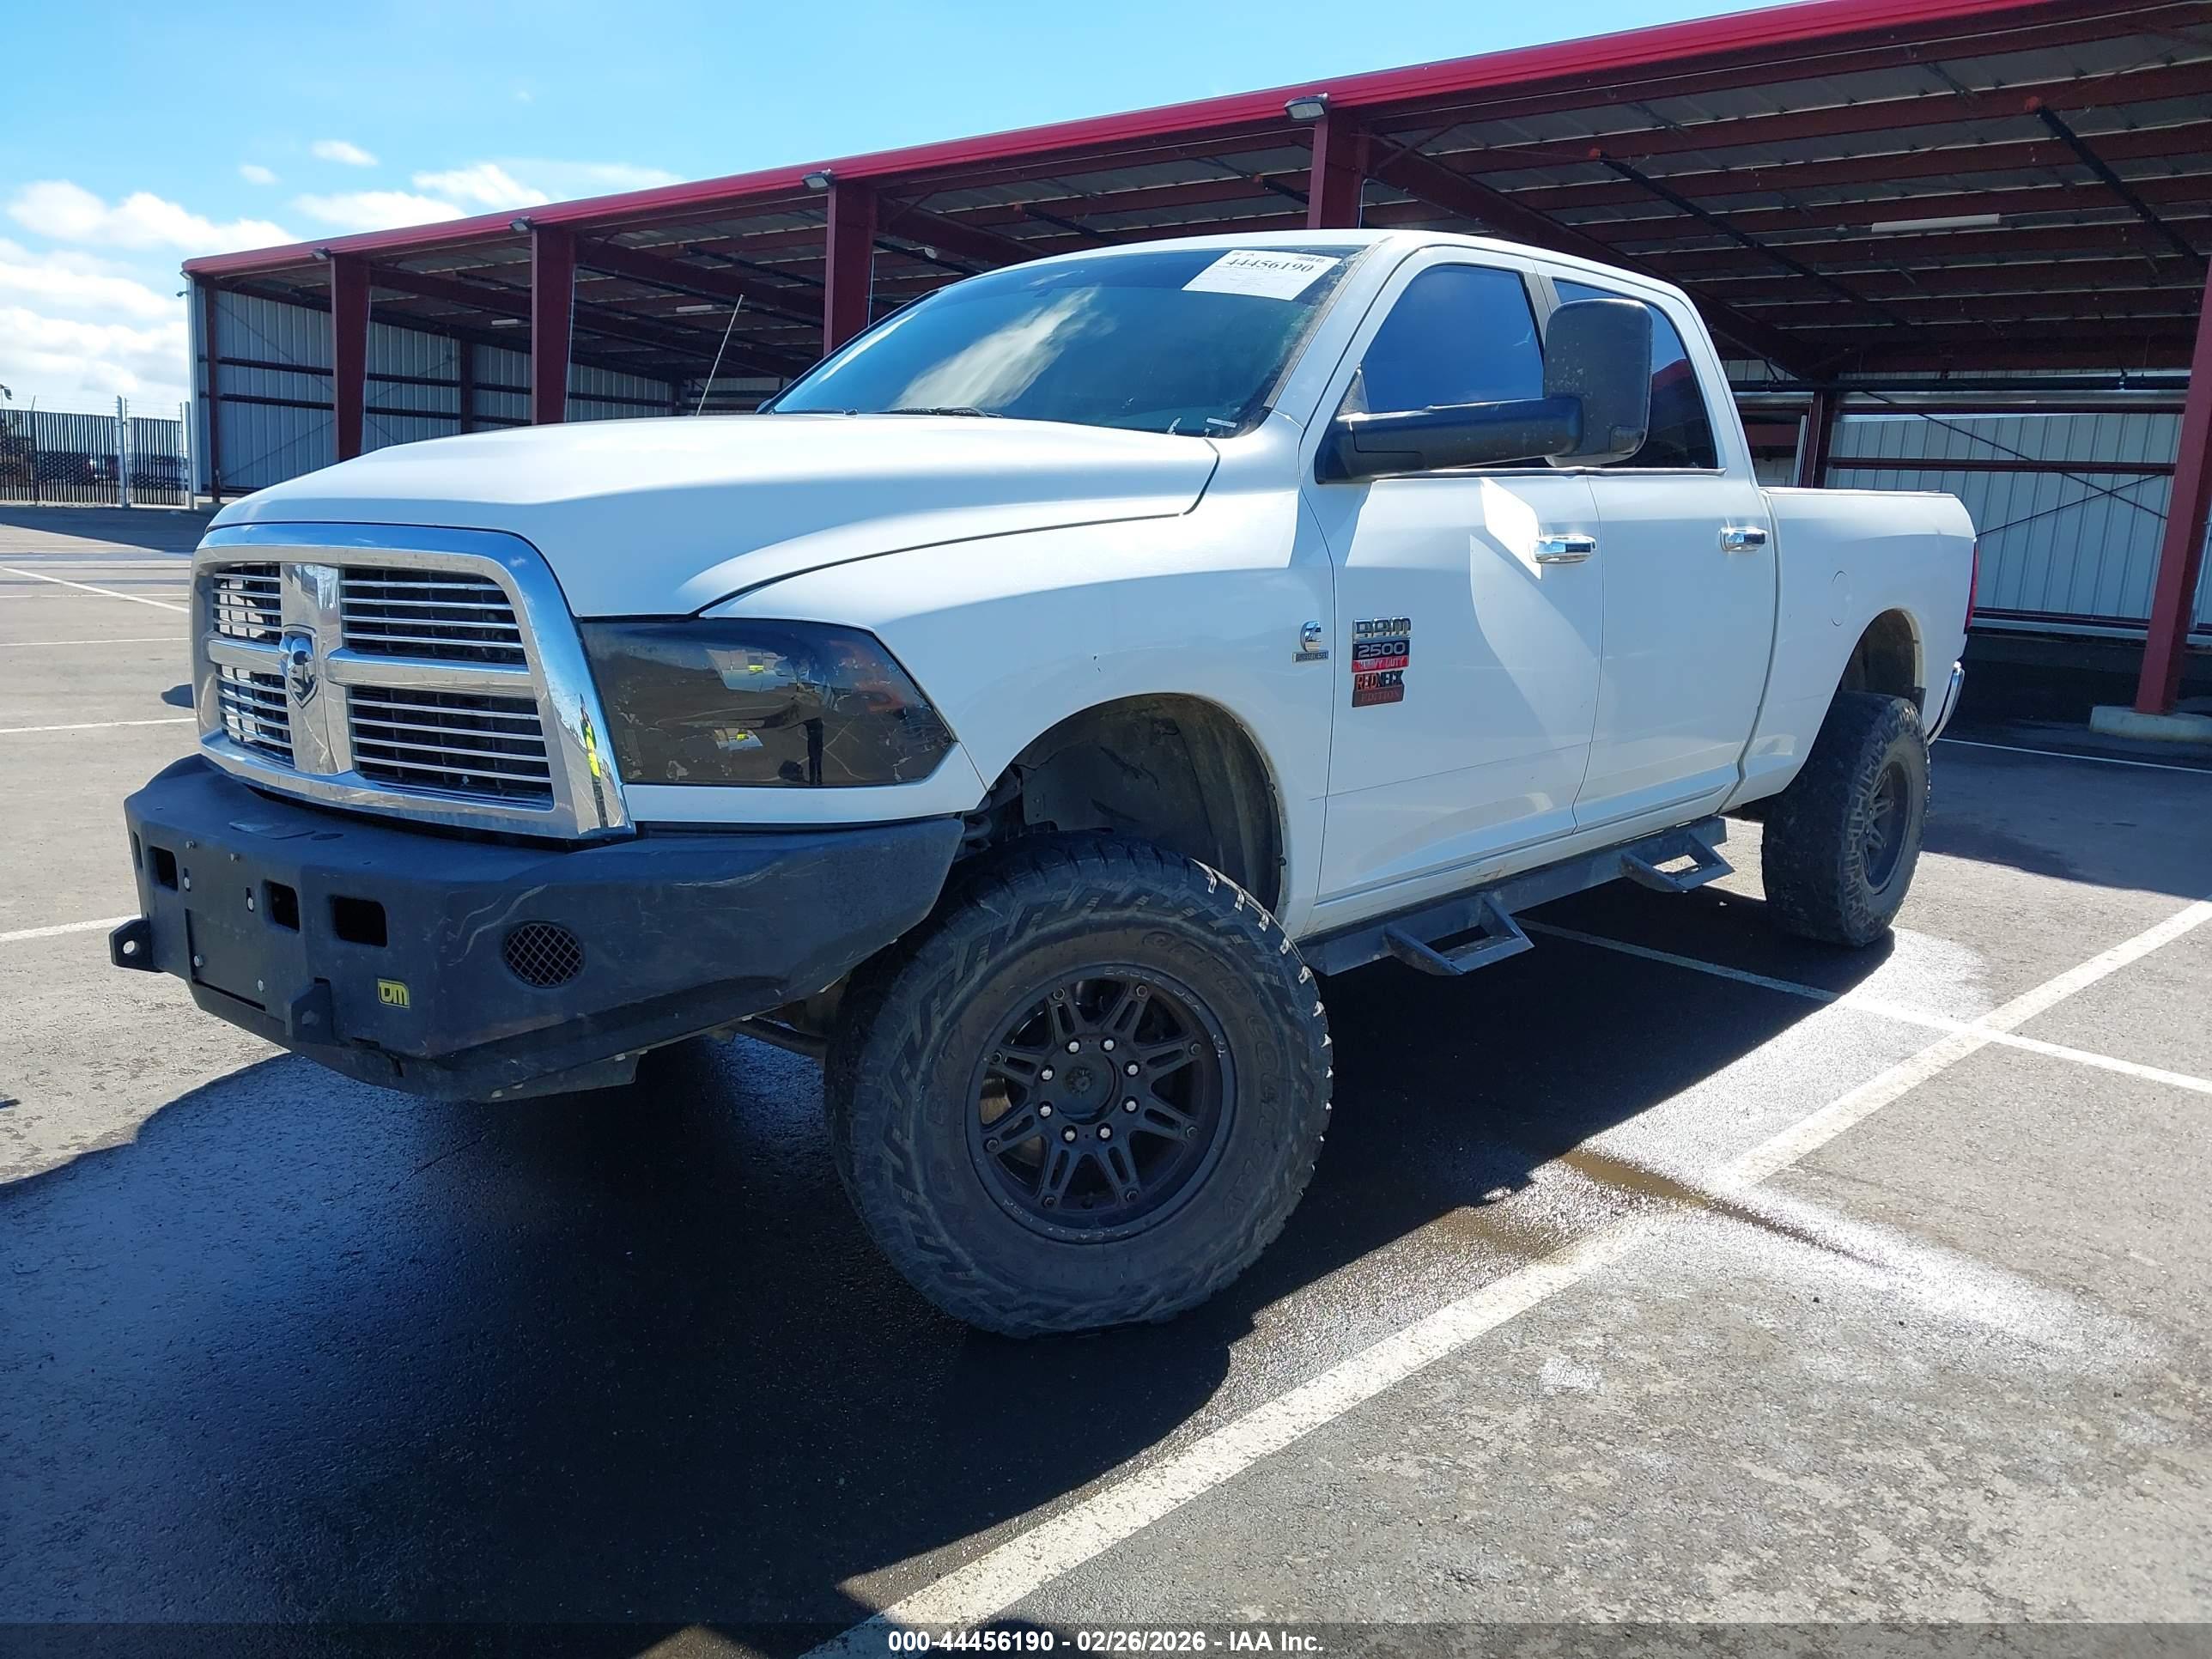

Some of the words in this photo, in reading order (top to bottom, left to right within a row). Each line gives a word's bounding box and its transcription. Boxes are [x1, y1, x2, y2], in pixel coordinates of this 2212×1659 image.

[1225, 258, 1314, 273] 44456190
[1353, 617, 1412, 639] RAM
[1358, 642, 1406, 658] 2500
